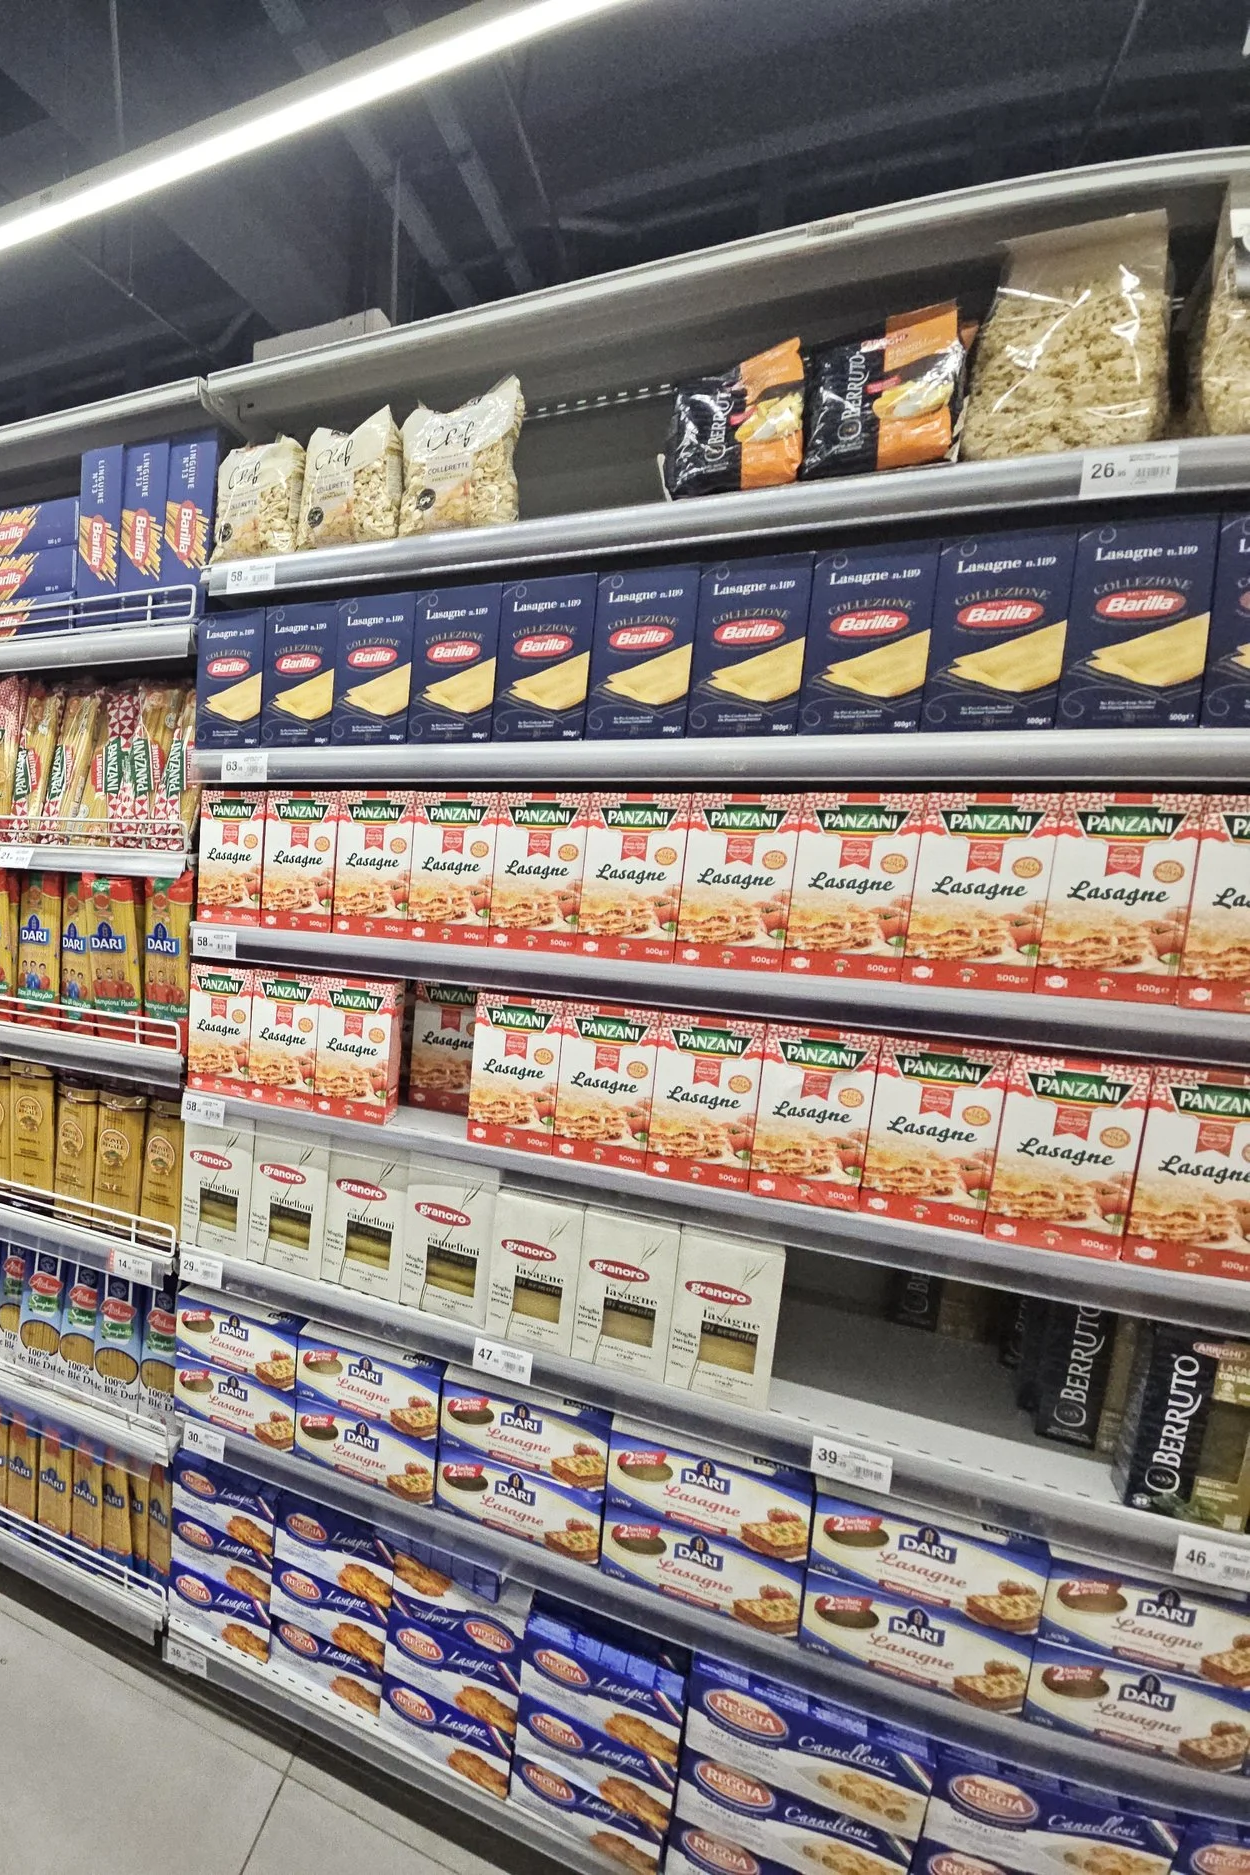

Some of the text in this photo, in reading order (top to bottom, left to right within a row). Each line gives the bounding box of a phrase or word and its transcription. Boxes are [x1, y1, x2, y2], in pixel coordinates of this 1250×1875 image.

[180, 506, 193, 555] Barilla
[1095, 544, 1163, 561] Lasagne
[957, 557, 1021, 574] Lasagne
[830, 569, 889, 585] Lasagne
[1093, 576, 1191, 595] COLLEZIONE
[609, 589, 657, 603] Lasagne
[713, 582, 766, 597] Lasagne
[955, 586, 1051, 607] COLLEZIONE
[513, 600, 557, 613] Lasagne
[828, 597, 915, 615] COLLEZIONE
[966, 603, 1036, 623] Barilla
[1106, 593, 1178, 613] Barilla
[347, 615, 384, 628] Lasagne
[426, 607, 466, 620] Lasagne
[711, 608, 790, 624] COLLEZIONE
[838, 613, 900, 632] Barilla
[206, 628, 237, 640] Lasagne
[275, 623, 308, 635] Lasagne
[616, 628, 670, 645] Barilla
[722, 623, 777, 639] Barilla
[433, 645, 476, 658] Barilla
[520, 637, 567, 652] Barilla
[281, 657, 316, 669] Barilla
[353, 650, 392, 664] Barilla
[212, 662, 245, 673] Barilla
[106, 741, 119, 794] PANZANI
[135, 739, 148, 795] PANZANI
[213, 804, 251, 818] PANZANI
[353, 806, 399, 821] PANZANI
[515, 808, 570, 825] PANZANI
[608, 809, 669, 827] PANZANI
[710, 811, 777, 829] PANZANI
[824, 812, 898, 831] PANZANI
[950, 814, 1033, 833] PANZANI
[1087, 815, 1173, 835] PANZANI
[207, 848, 252, 863] Lasagne
[346, 852, 399, 869] Lasagne
[505, 860, 569, 879] Lasagne
[596, 863, 666, 883] Lasagne
[696, 867, 775, 889] Lasagne
[808, 870, 895, 893] Lasagne
[932, 875, 1028, 899] Lasagne
[1067, 880, 1169, 904] Lasagne
[21, 929, 47, 943] DARI
[91, 936, 122, 950] DARI
[148, 938, 177, 952] DARI
[201, 977, 239, 993] PANZANI
[332, 991, 378, 1009] PANZANI
[197, 1019, 241, 1036] Lasagne
[492, 1007, 546, 1028] PANZANI
[581, 1017, 641, 1039] PANZANI
[326, 1037, 378, 1057] Lasagne
[679, 1032, 742, 1054] PANZANI
[786, 1044, 857, 1069] PANZANI
[483, 1060, 545, 1079] Lasagne
[903, 1057, 981, 1082] PANZANI
[571, 1072, 638, 1094] Lasagne
[1037, 1074, 1121, 1101] PANZANI
[667, 1086, 741, 1110] Lasagne
[1180, 1090, 1250, 1113] PANZAN
[773, 1101, 852, 1125] Lasagne
[887, 1116, 977, 1143] Lasagne
[193, 1152, 229, 1167] granoro
[1017, 1137, 1115, 1166] Lasagne
[263, 1166, 302, 1182] granoro
[200, 1179, 240, 1196] cannelloni
[340, 1180, 383, 1199] granoro
[270, 1193, 314, 1213] cannelloni
[347, 1209, 395, 1231] cannelloni
[420, 1204, 466, 1224] granoro
[427, 1234, 480, 1257] cannelloni
[505, 1241, 552, 1260] granoro
[516, 1264, 564, 1285] lasagne
[595, 1261, 644, 1279] granoro
[605, 1285, 657, 1306] lasagne
[691, 1282, 747, 1304] granoro
[703, 1309, 760, 1331] lasagne
[220, 1322, 247, 1341] DARI
[209, 1335, 255, 1360] Lasagne
[104, 1377, 126, 1389] 100%
[350, 1364, 380, 1384] DARI
[104, 1387, 118, 1396] Blé
[336, 1377, 390, 1404] Lasagne
[502, 1412, 540, 1432] DARI
[487, 1427, 550, 1454] Lasagne
[683, 1469, 730, 1493] DARI
[665, 1485, 740, 1519] Lasagne
[290, 1517, 325, 1541] REGGIA
[903, 1537, 951, 1561] DARI
[876, 1549, 968, 1589] Lasagne
[177, 1578, 211, 1601] REGGIA
[215, 1593, 252, 1614] Lasagne
[326, 1590, 369, 1613] Lasagne
[1141, 1602, 1191, 1624] DARI
[1113, 1615, 1204, 1650] Lasagne
[401, 1631, 443, 1660] REGGIA
[449, 1651, 498, 1674] Lasagne
[537, 1655, 589, 1686] REGGIA
[596, 1676, 652, 1701] Lasagne
[711, 1695, 786, 1733] REGGIA
[531, 1718, 584, 1750] REGGIA
[591, 1741, 646, 1766] Lasagne
[798, 1735, 891, 1768] Cannelloni
[700, 1765, 771, 1804] REGGIA
[956, 1776, 1033, 1816] REGGIA
[784, 1806, 871, 1838] Cannelloni
[1048, 1814, 1140, 1839] Cannelloni
